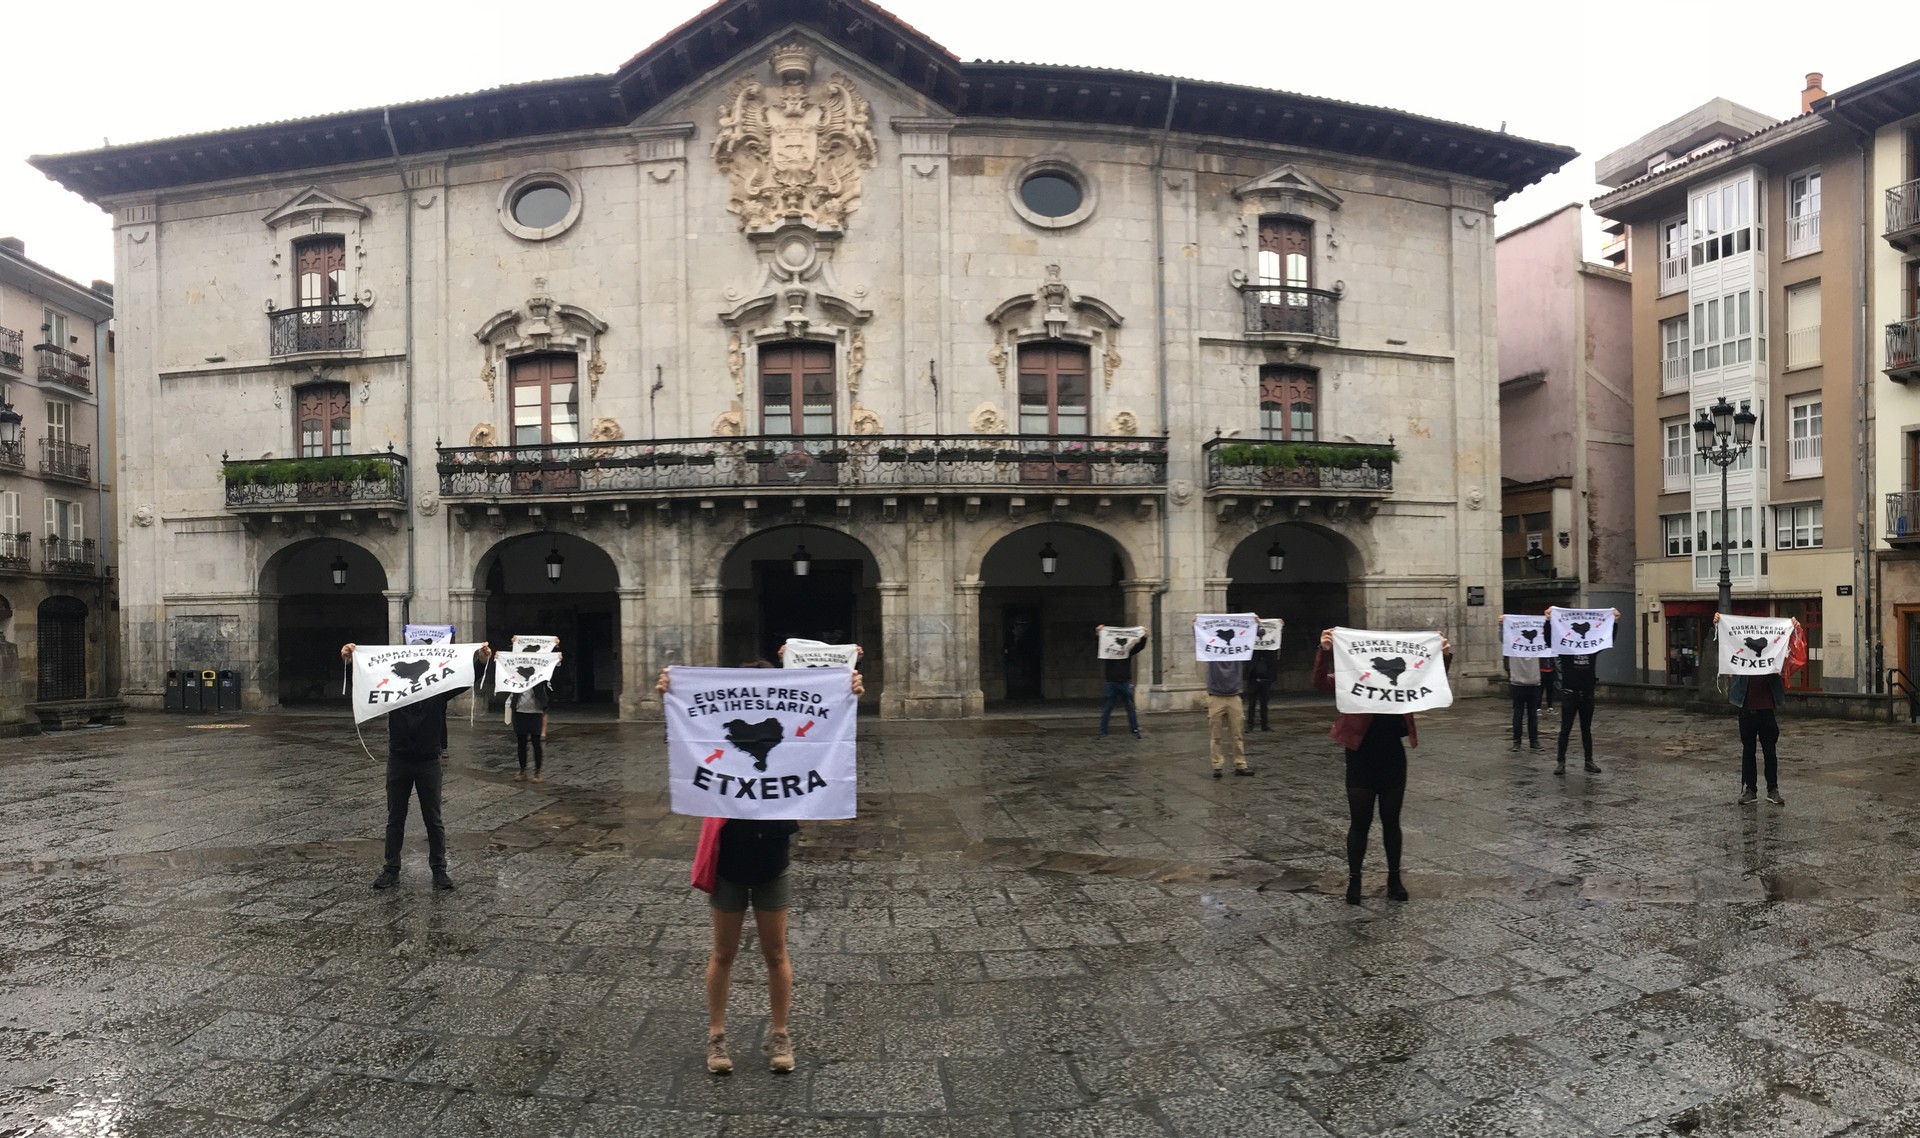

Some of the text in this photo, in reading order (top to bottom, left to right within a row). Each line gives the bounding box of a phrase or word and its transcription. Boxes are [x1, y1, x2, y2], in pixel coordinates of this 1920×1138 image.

[1204, 644, 1251, 655] ETXERA
[1351, 639, 1428, 652] EUSKAL PRESO
[1560, 637, 1605, 649] ETXERA
[368, 651, 458, 667] ETA IHESLARIA
[370, 649, 413, 662] EUSKAL
[1370, 646, 1431, 660] IHESLARIAK
[1730, 654, 1775, 668] ETXER
[368, 667, 456, 704] ETXERA
[1350, 682, 1433, 703] ETXERA
[693, 687, 823, 704] EUSKAL PRESO
[688, 699, 830, 719] ETA IHESLARIAK
[692, 765, 828, 800] ETXERA
